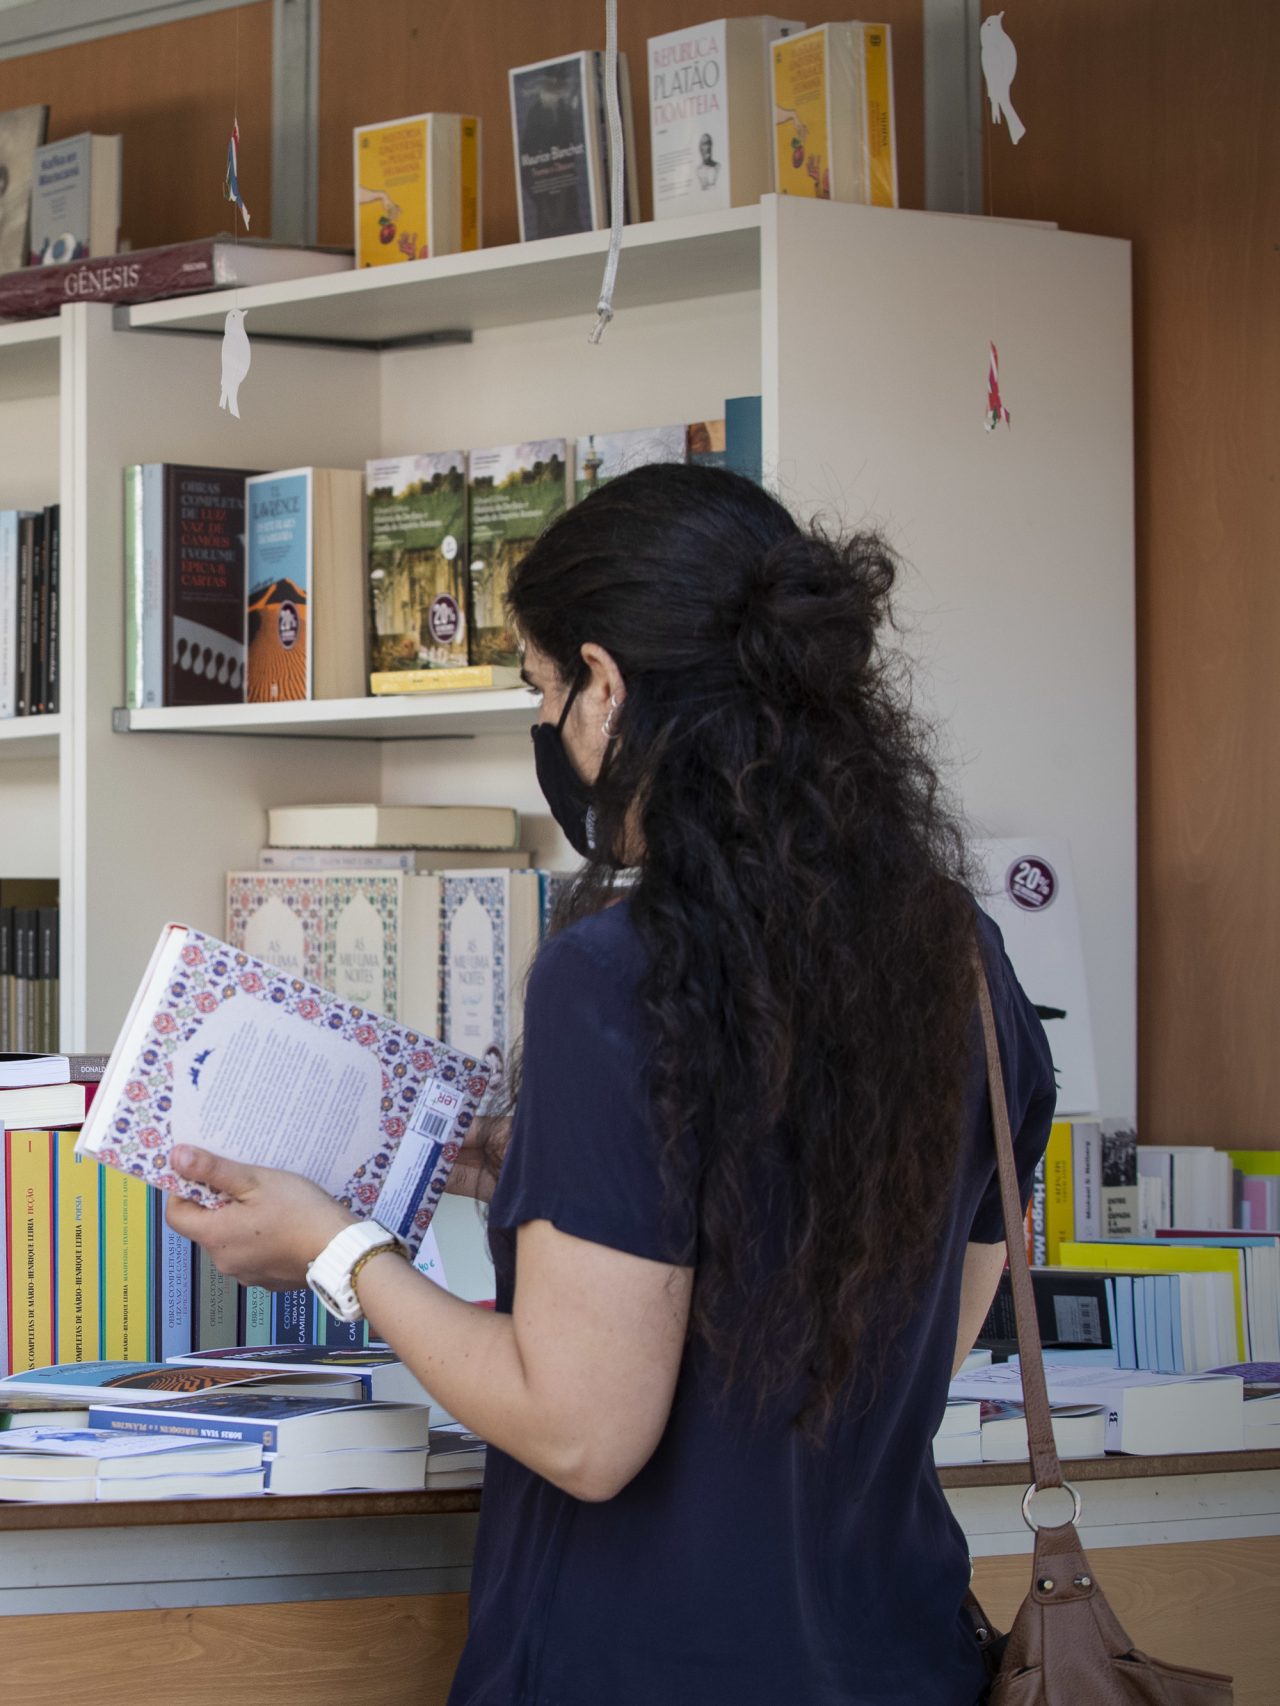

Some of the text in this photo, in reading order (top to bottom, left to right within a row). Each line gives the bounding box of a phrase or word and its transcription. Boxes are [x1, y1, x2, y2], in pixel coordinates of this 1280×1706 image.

[653, 60, 720, 100] PLATÃO
[64, 265, 140, 298] GÊNESIS
[1014, 861, 1050, 896] 20%
[26, 1188, 36, 1216] FICÇÃO
[75, 1195, 84, 1222] POESIA
[1032, 1182, 1046, 1232] Hugo
[27, 1218, 36, 1246] LEIRIA
[75, 1224, 84, 1250] LEIRIA
[168, 1233, 176, 1328] OBRAS COMPLETAS DE
[175, 1273, 182, 1286] DE
[28, 1308, 36, 1318] DE
[75, 1313, 84, 1324] DE
[284, 1290, 292, 1330] CONTOS
[28, 1319, 36, 1362] COMPLETAS
[123, 1353, 130, 1362] DE
[201, 1429, 220, 1438] VIAN
[221, 1430, 242, 1440] BORIS
